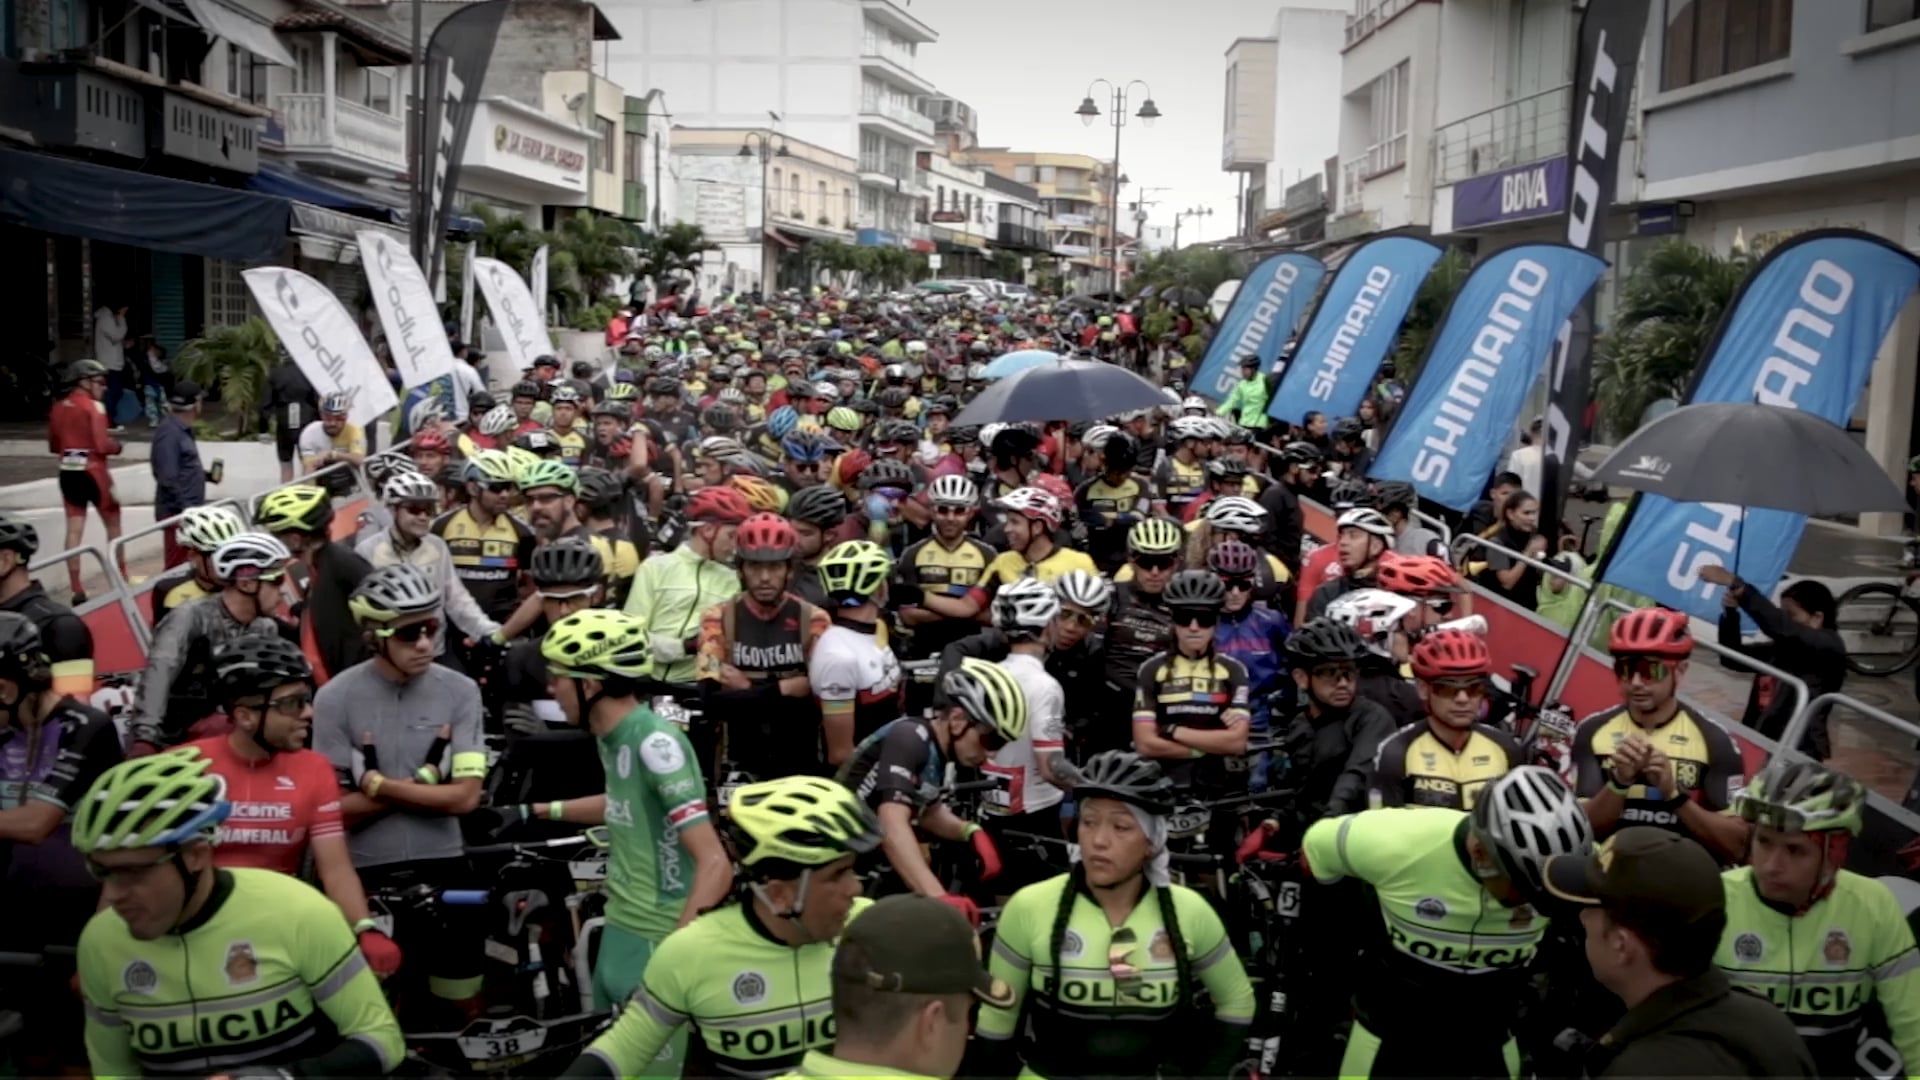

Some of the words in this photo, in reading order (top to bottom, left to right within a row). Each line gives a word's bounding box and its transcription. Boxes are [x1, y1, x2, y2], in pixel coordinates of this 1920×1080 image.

[1502, 168, 1548, 214] BBVA
[1216, 261, 1299, 394] SHIMANO
[1309, 264, 1392, 402] SHIMANO
[1411, 258, 1548, 488] SHIMANO
[1668, 258, 1855, 600] SHANO
[719, 1014, 837, 1055] POLIC
[1766, 984, 1861, 1010] LICIA
[486, 1038, 519, 1056] 38
